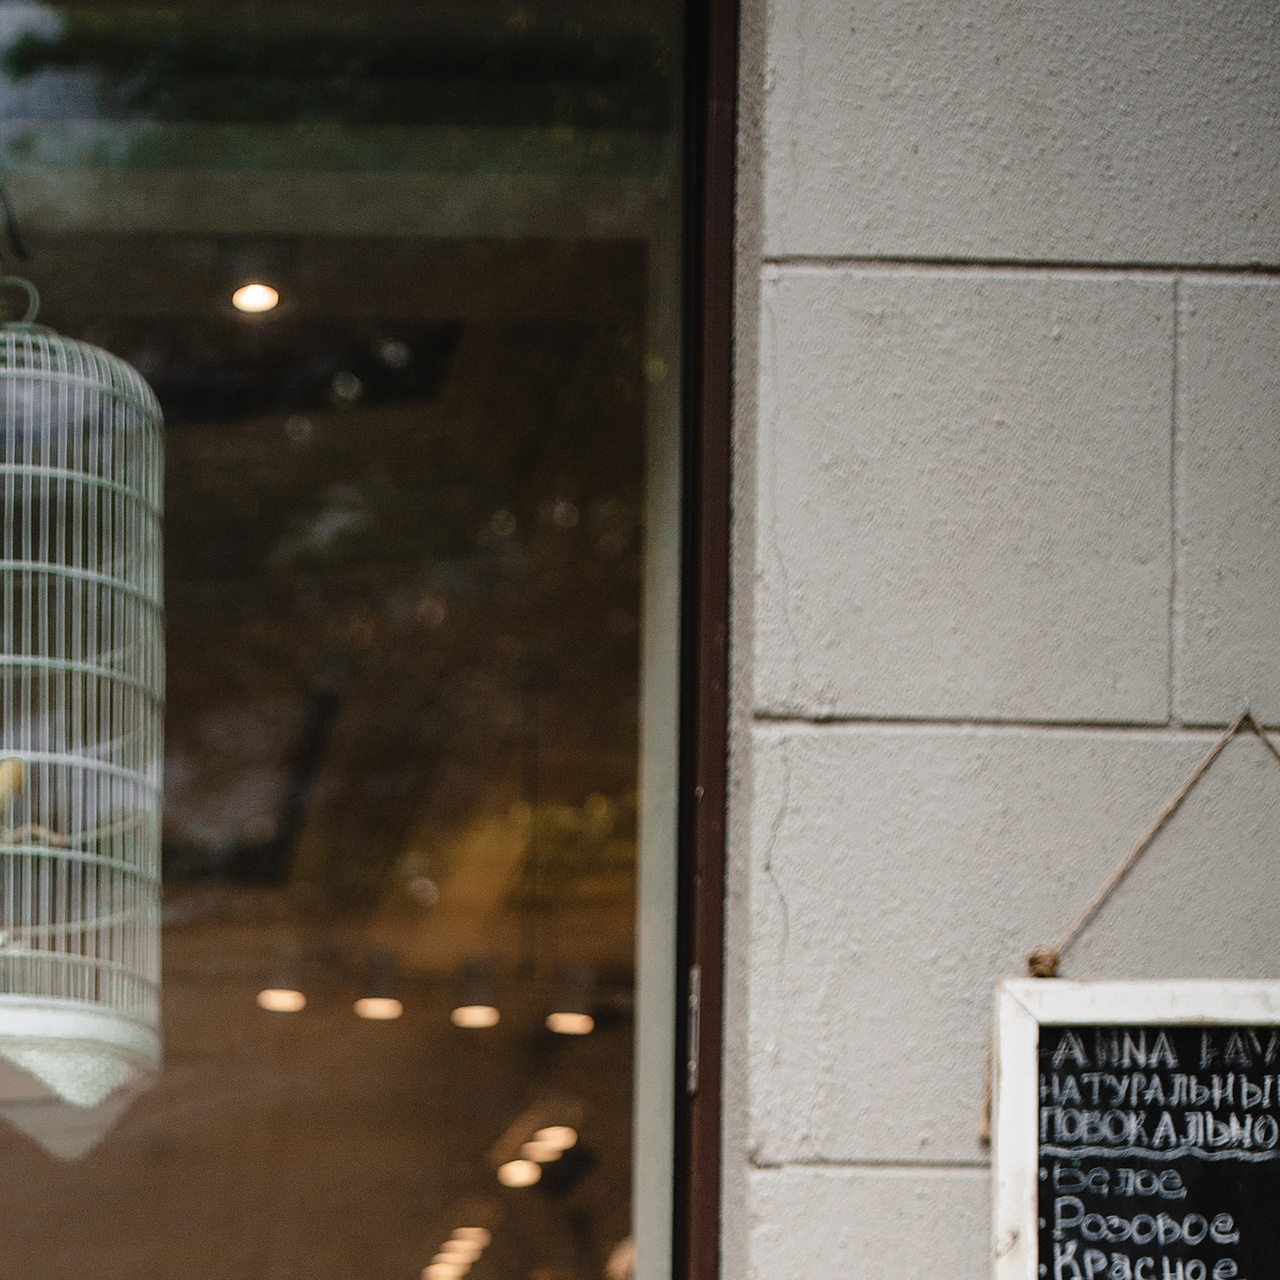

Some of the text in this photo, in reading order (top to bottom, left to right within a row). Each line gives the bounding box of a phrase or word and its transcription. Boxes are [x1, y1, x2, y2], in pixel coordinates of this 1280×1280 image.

[1038, 1070, 1280, 1110] НАТУРАЛЬНЫ
[1052, 1159, 1188, 1200] Белое
[1052, 1195, 1241, 1246] Розовое
